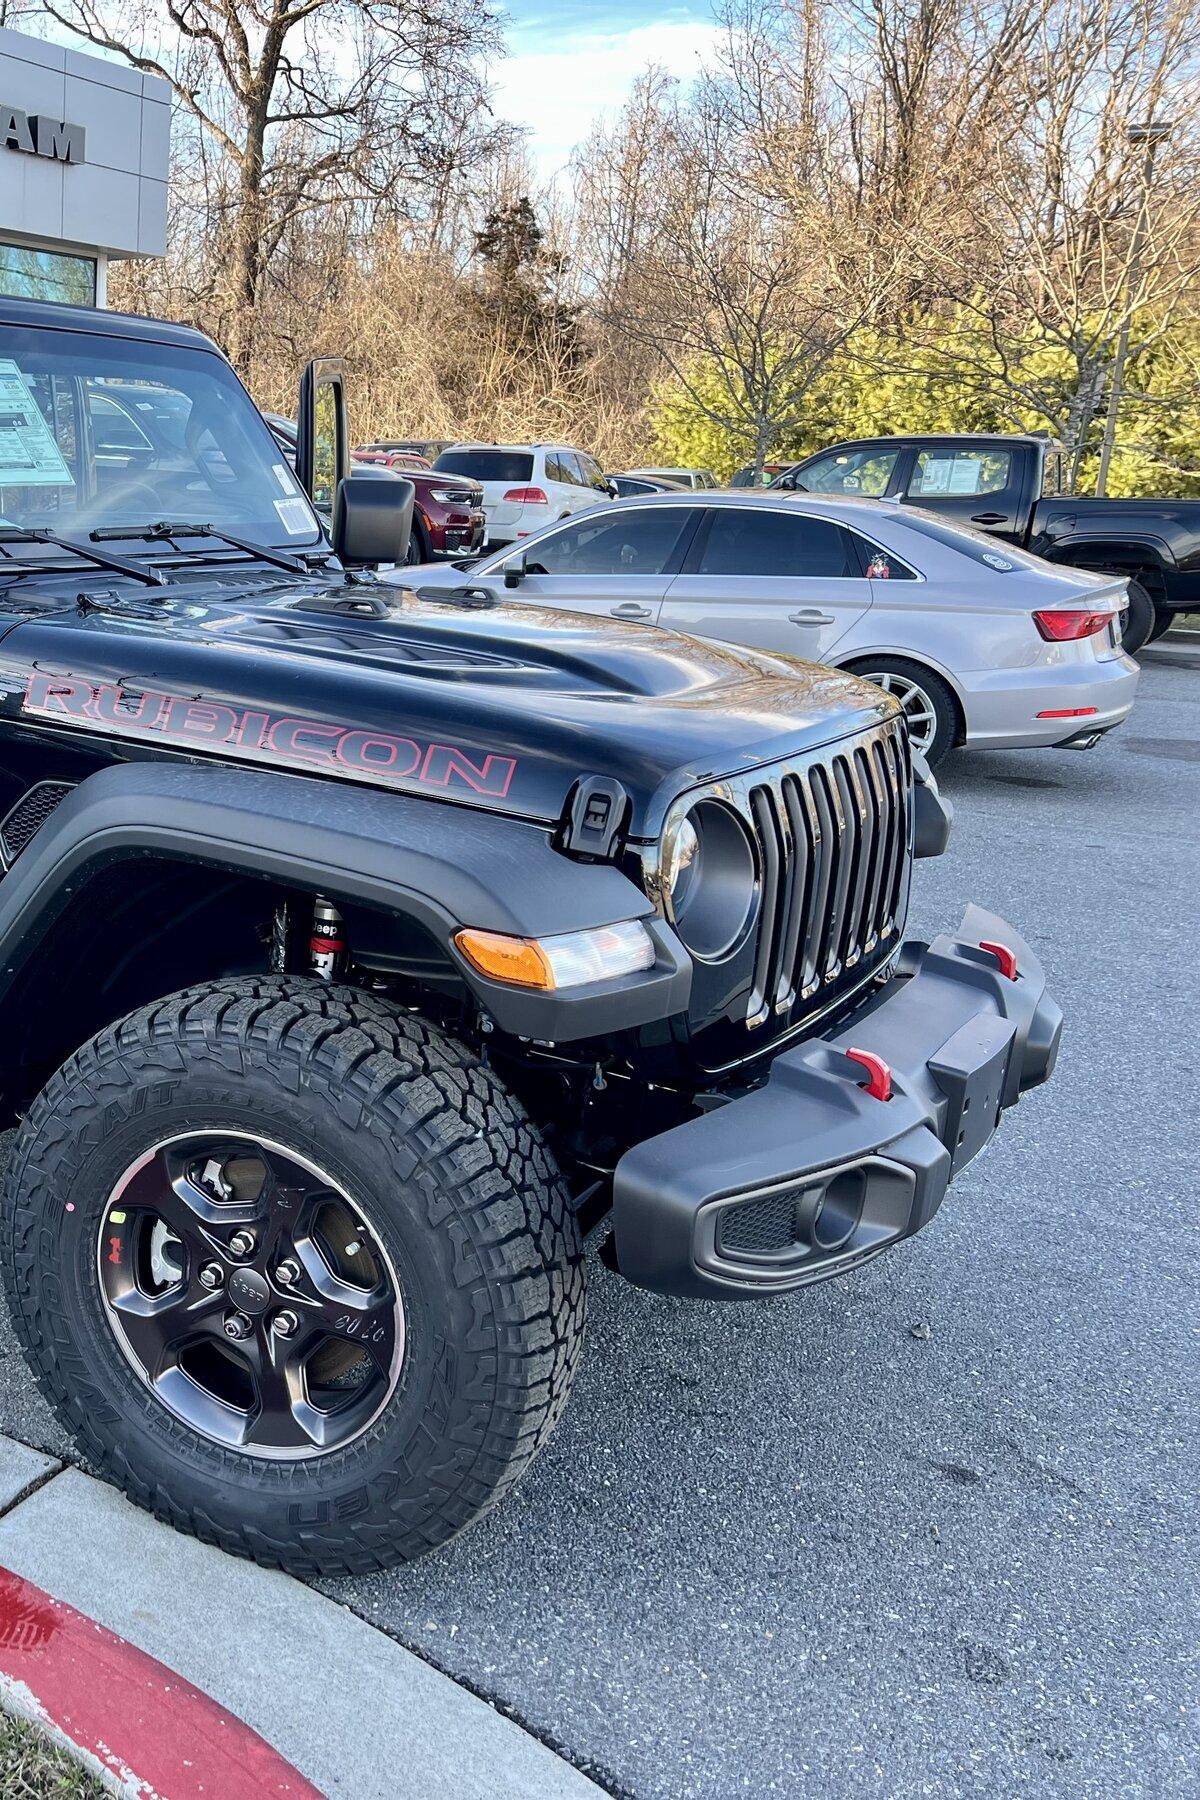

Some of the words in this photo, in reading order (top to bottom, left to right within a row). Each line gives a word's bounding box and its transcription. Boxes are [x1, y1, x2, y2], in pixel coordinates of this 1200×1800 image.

[22, 673, 518, 798] RUBICON
[313, 921, 338, 937] Jeep
[103, 1079, 182, 1137] A/T
